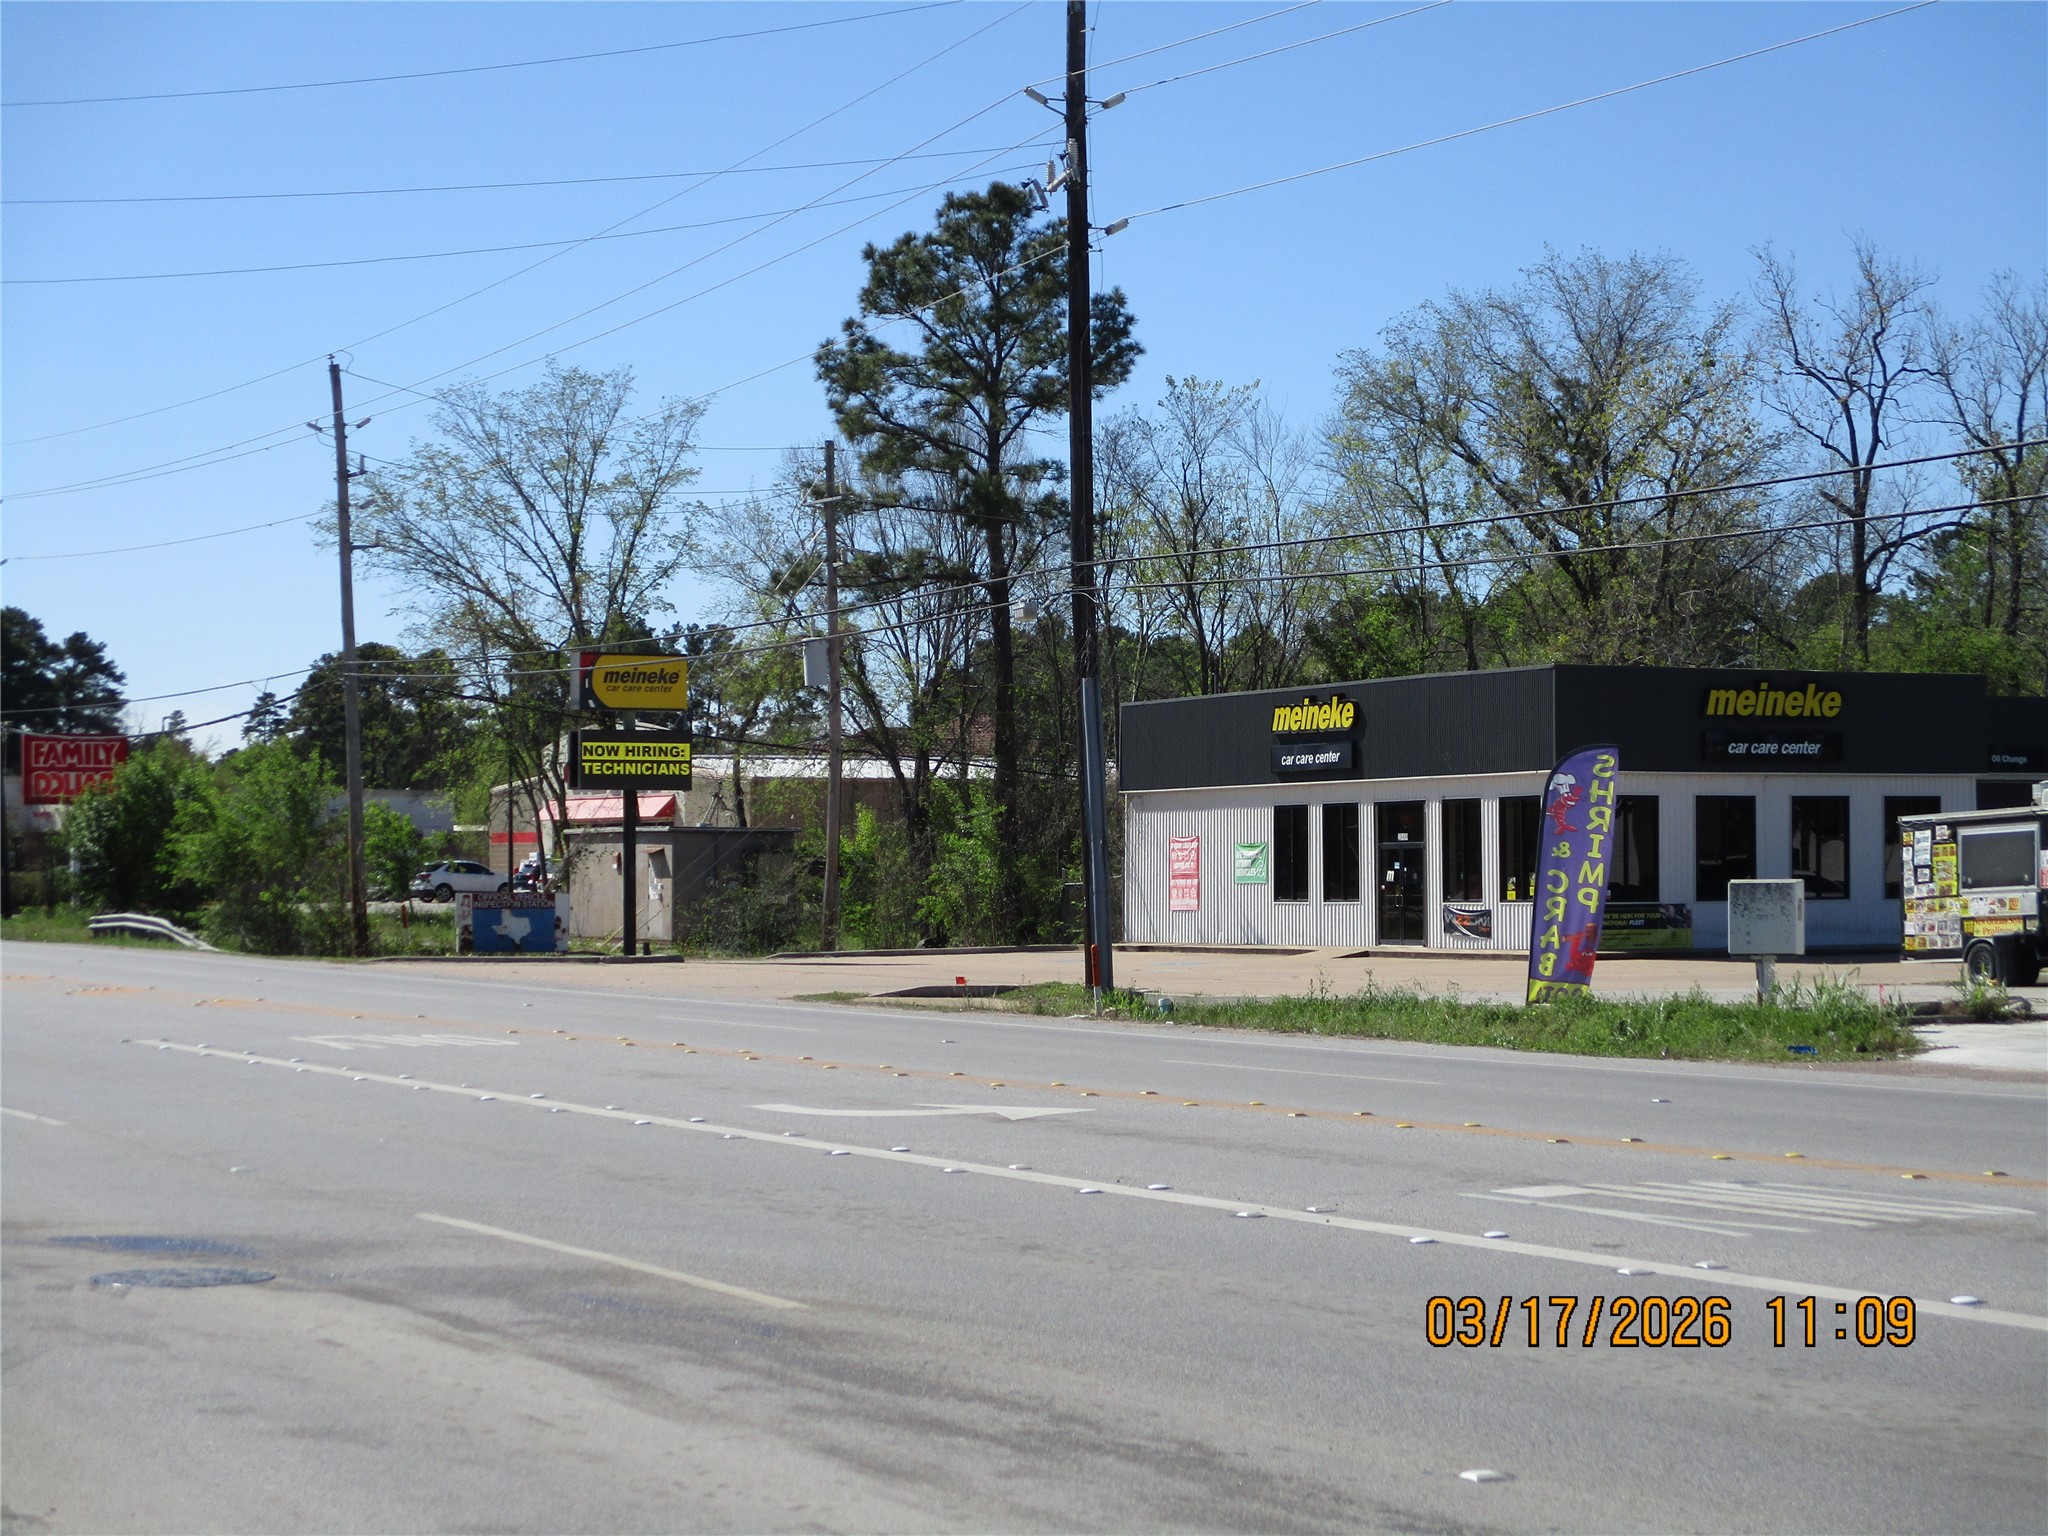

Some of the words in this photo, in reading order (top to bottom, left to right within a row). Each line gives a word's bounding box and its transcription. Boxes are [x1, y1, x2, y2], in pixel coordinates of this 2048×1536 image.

[602, 667, 680, 685] meineke
[622, 685, 642, 693] care
[644, 684, 673, 693] center
[1706, 682, 1842, 718] meineke
[1271, 695, 1354, 732] meineke
[31, 740, 121, 768] FAMILY
[582, 745, 620, 757] NOW
[625, 745, 685, 758] HIRING:
[1727, 742, 1749, 755] car
[1750, 742, 1779, 755] care
[1781, 740, 1822, 755] center
[1281, 755, 1296, 766] car
[1295, 753, 1314, 765] care
[1315, 750, 1341, 764] center
[582, 762, 690, 776] TECHNICIANS
